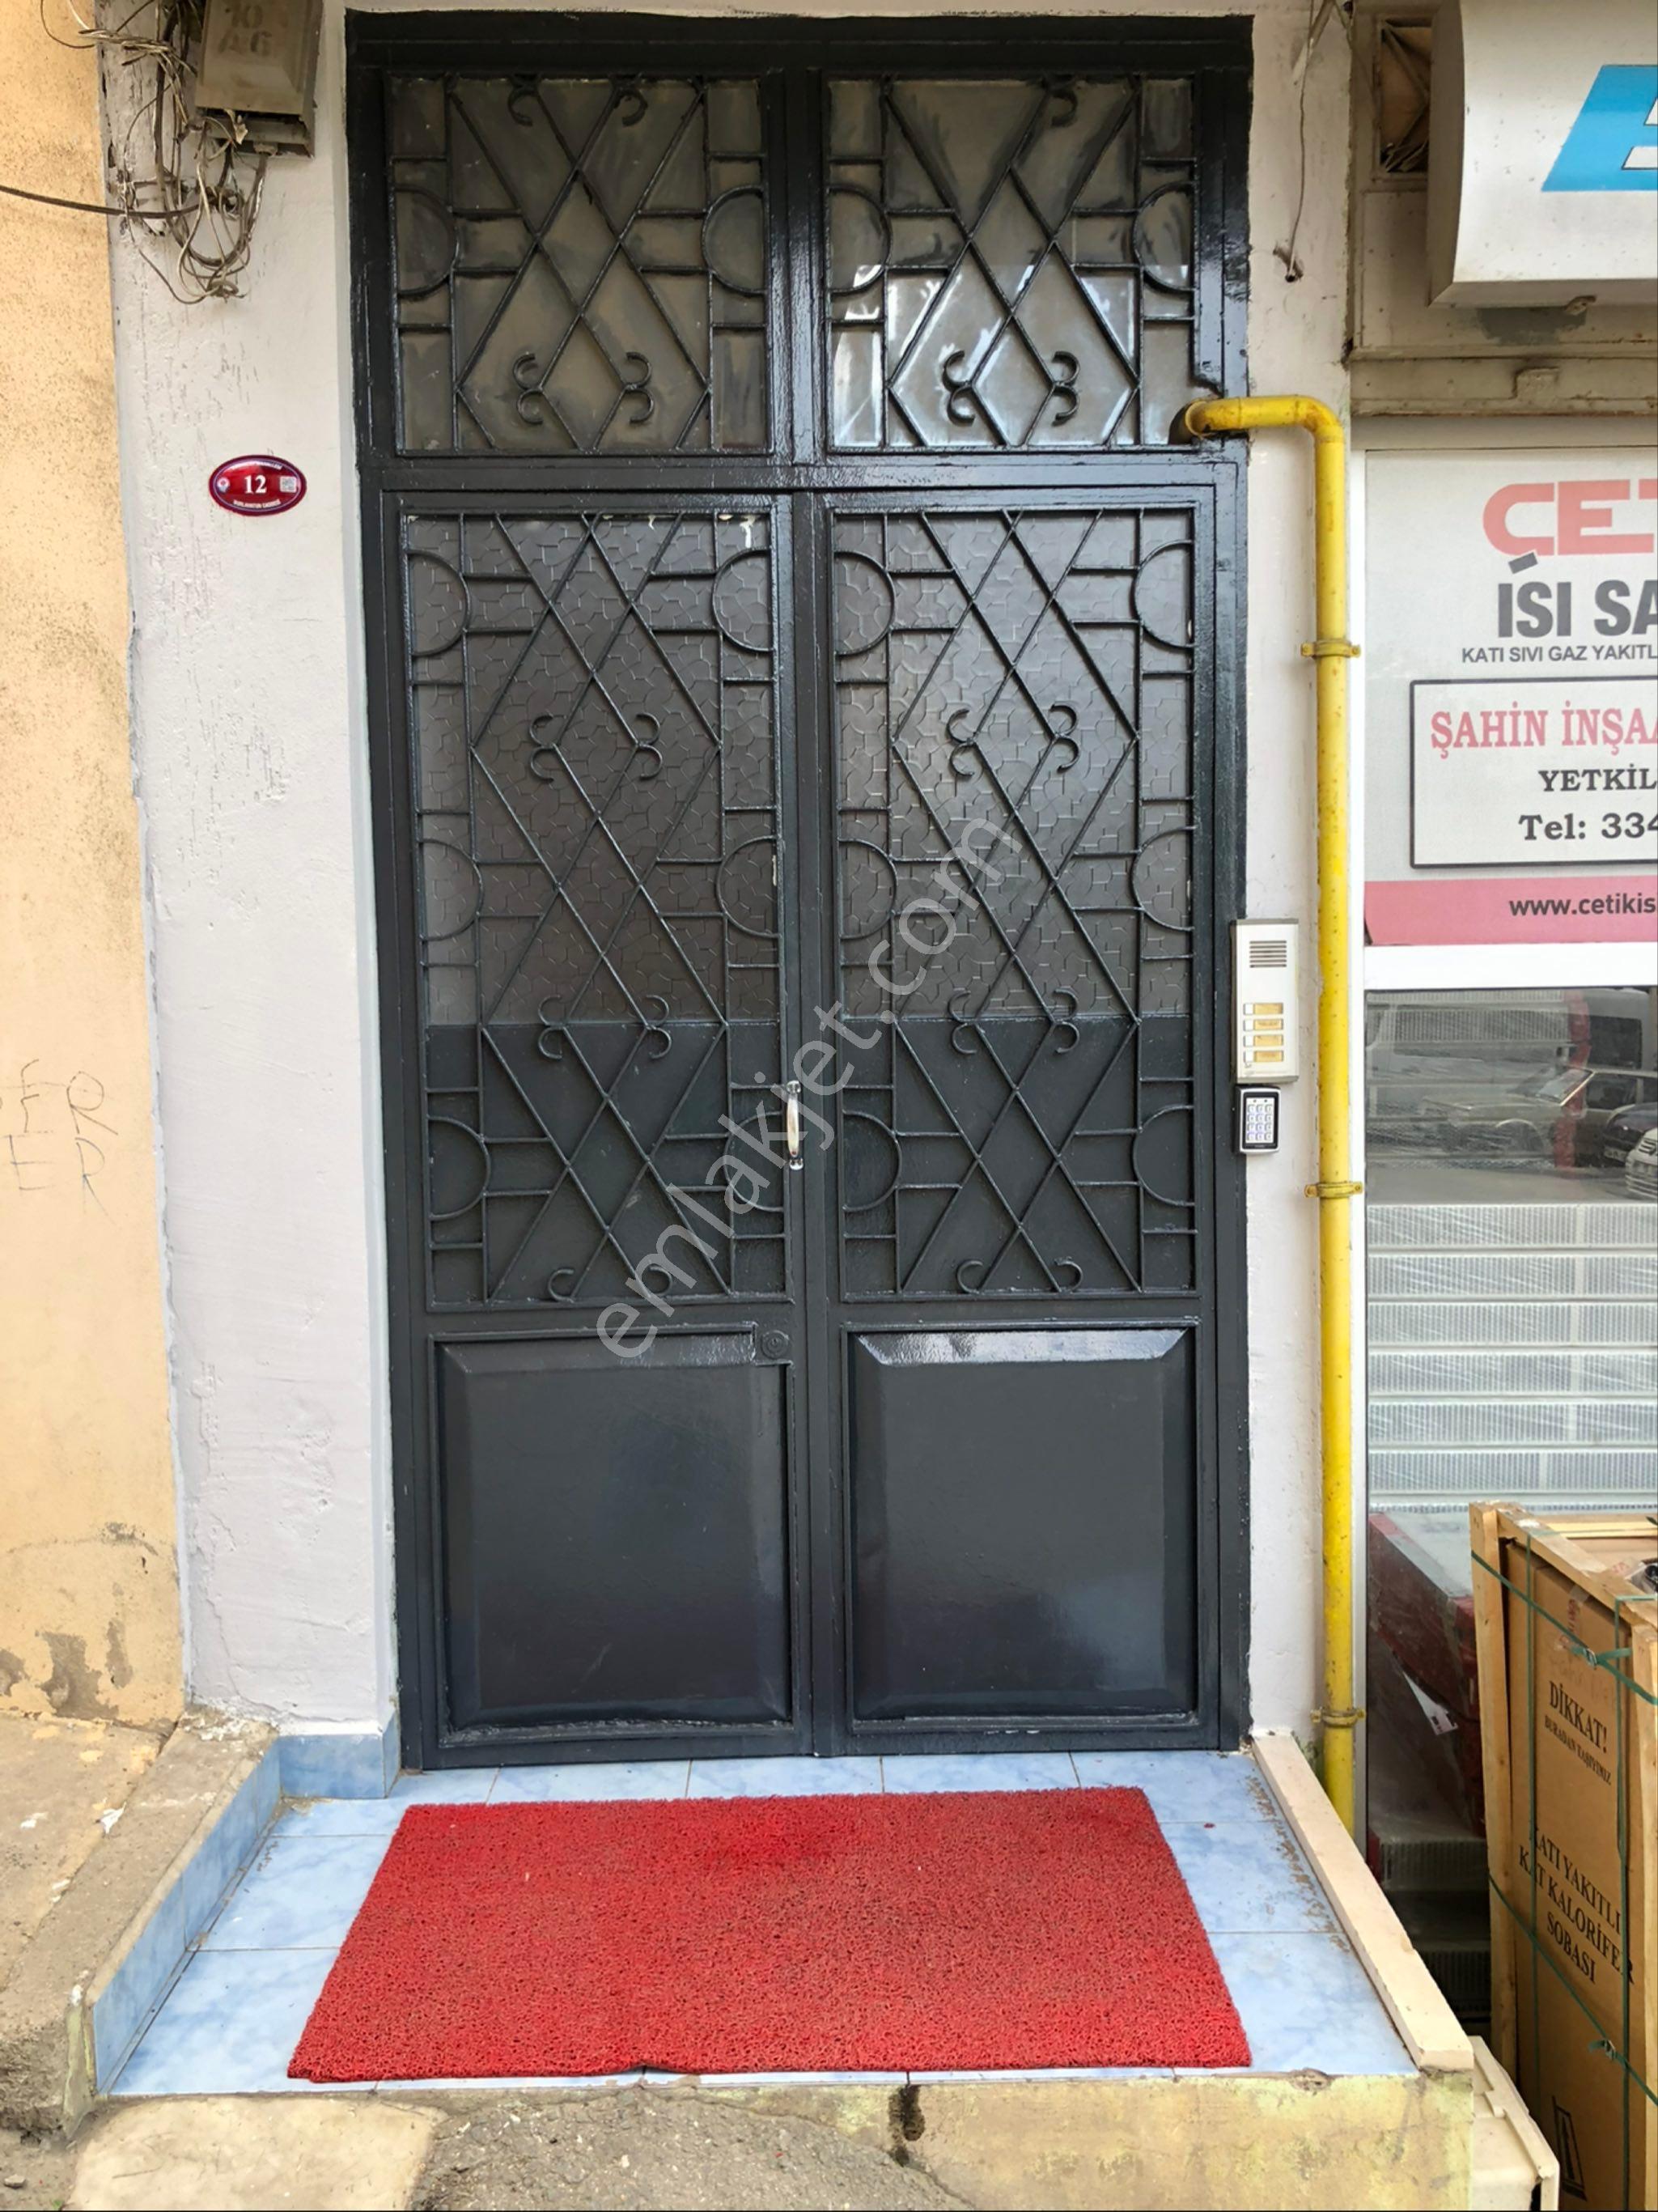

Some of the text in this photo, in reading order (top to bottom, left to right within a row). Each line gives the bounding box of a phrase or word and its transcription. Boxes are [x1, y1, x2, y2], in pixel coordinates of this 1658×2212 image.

[244, 474, 267, 495] 12
[1498, 581, 1571, 639] ISI
[1461, 644, 1657, 663] KATI SIVI GAZ YAKITL
[1431, 700, 1657, 759] ŞAHİN İNŞA
[1538, 763, 1657, 792] YETKİL
[1518, 813, 1586, 841] Tel:
[1509, 893, 1657, 916] www.cetikis
[1549, 1680, 1607, 1753] DİKKAT!
[1519, 1845, 1546, 1890] KT
[1563, 1853, 1621, 1935] YAKITLI
[1547, 1911, 1596, 1984] SOBASI
